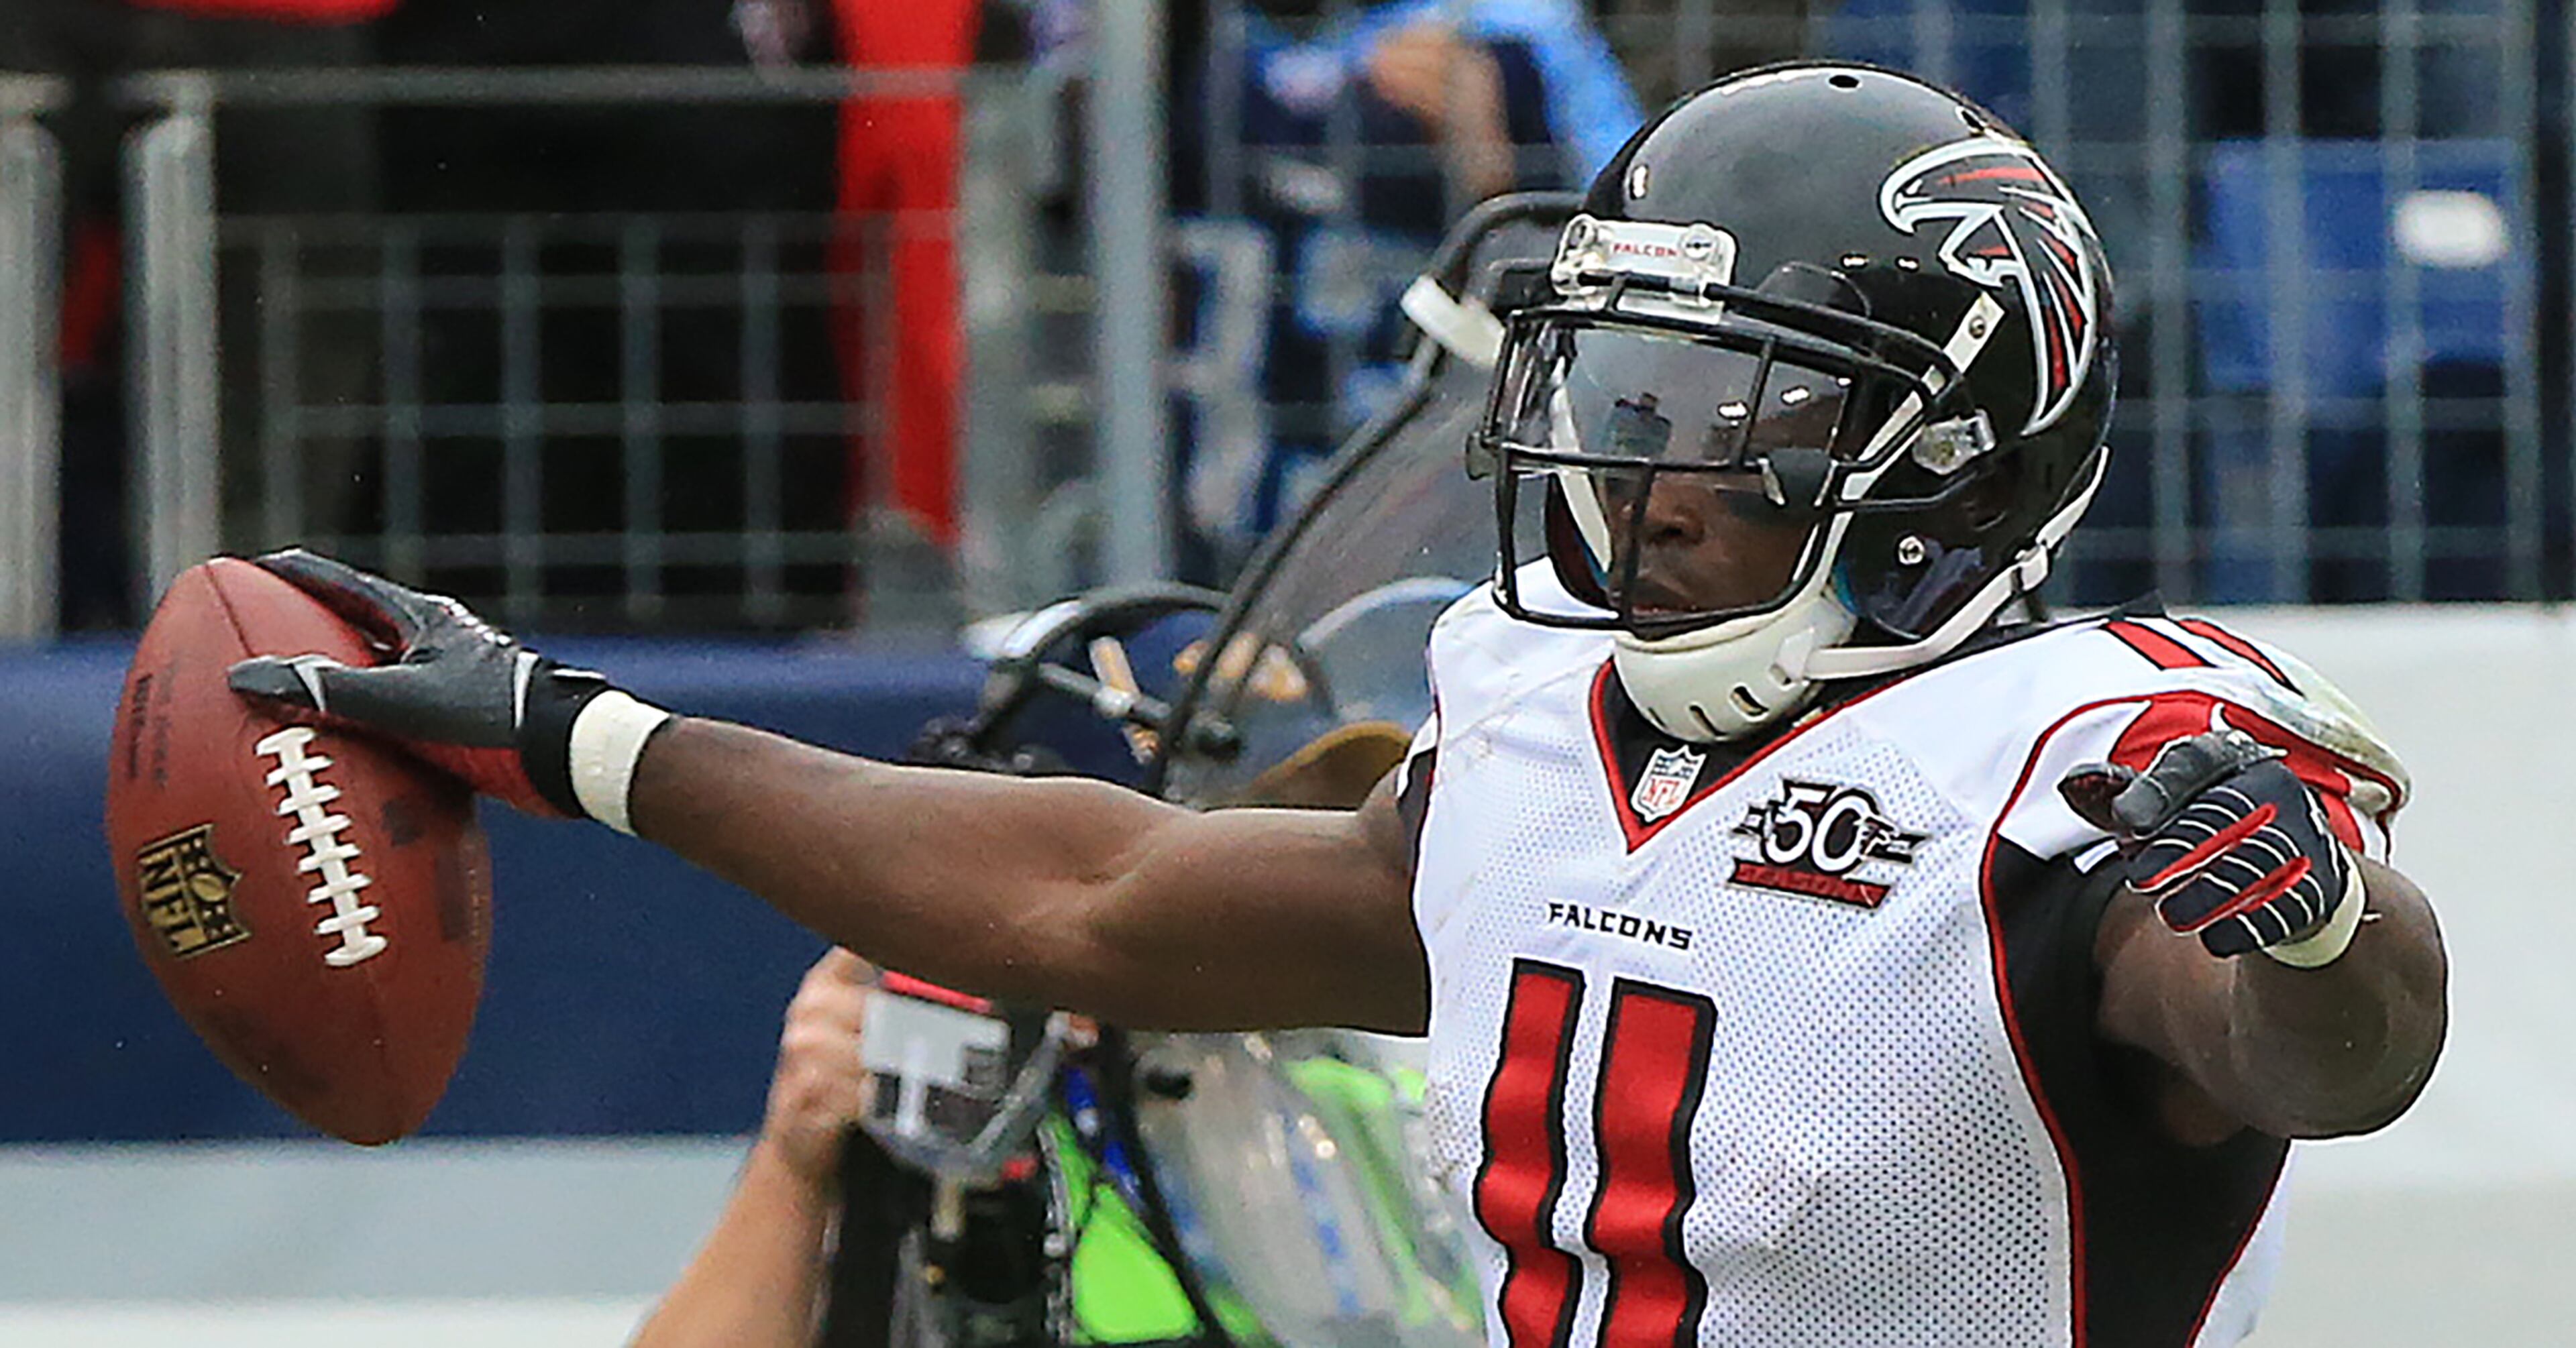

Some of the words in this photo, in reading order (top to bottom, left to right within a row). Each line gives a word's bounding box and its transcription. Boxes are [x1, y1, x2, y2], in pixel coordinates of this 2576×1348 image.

[1613, 243, 1678, 257] FALCON
[1641, 778, 1681, 807] NFL
[1764, 783, 1876, 873] 50
[138, 846, 208, 951] NFL
[1548, 903, 1693, 950] FALCONS
[1472, 958, 1718, 1348] 11
